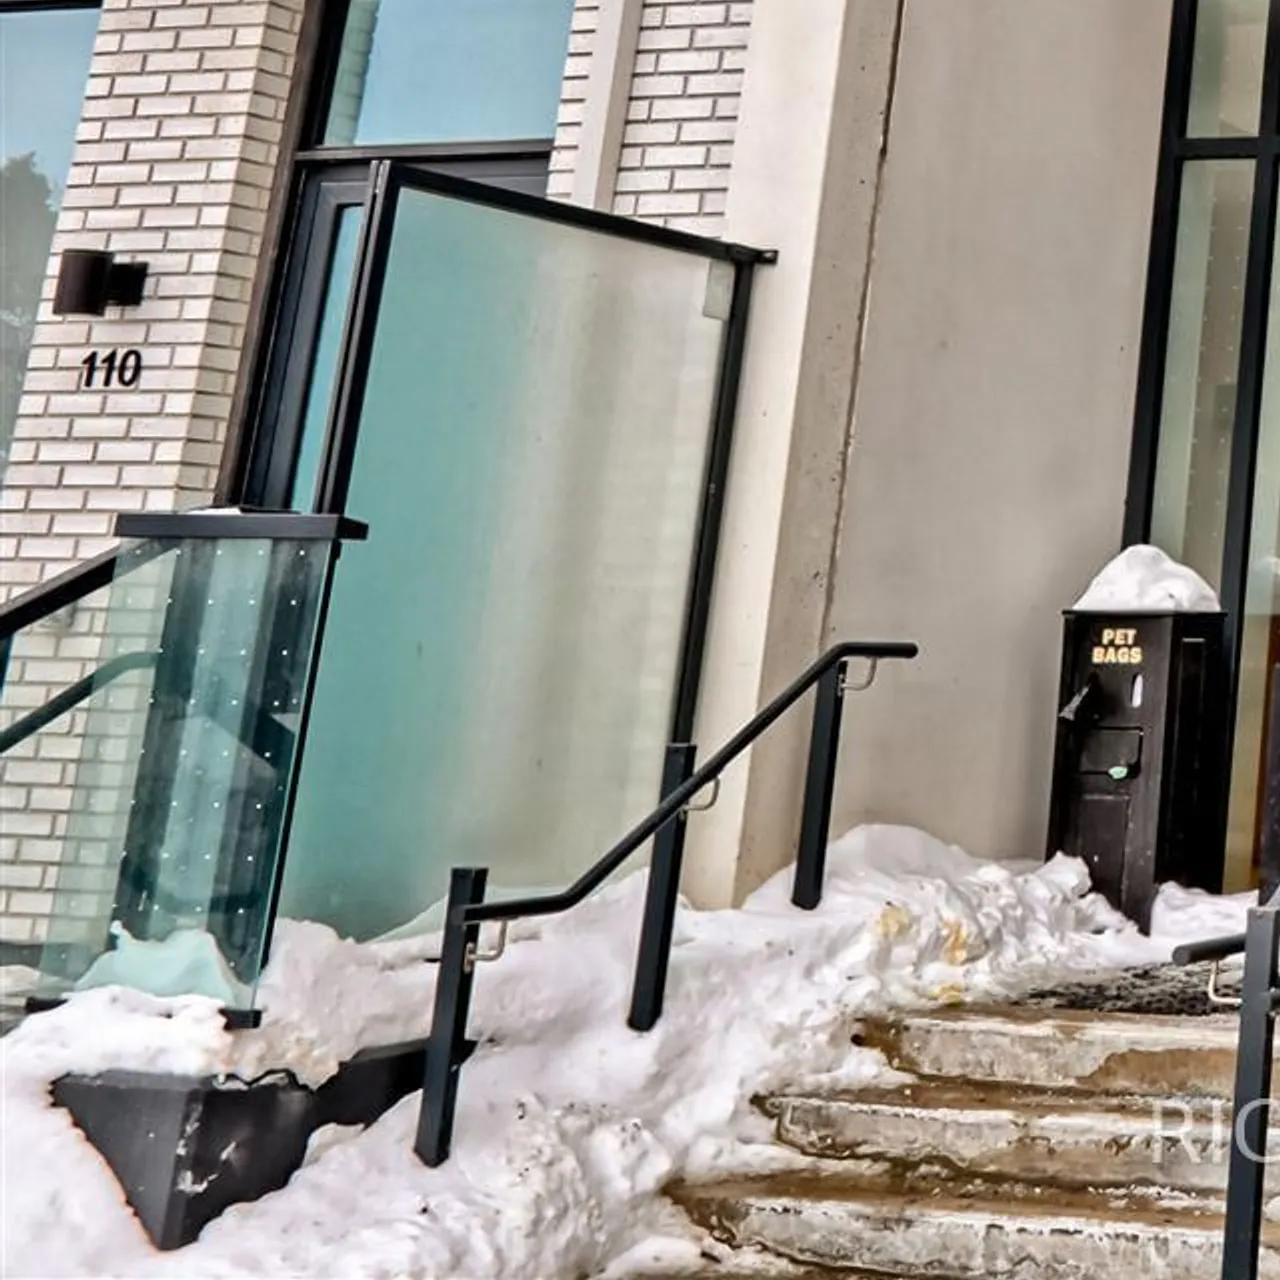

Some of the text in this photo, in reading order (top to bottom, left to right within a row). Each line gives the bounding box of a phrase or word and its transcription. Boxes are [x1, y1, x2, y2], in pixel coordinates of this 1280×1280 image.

[82, 348, 142, 387] 110
[1102, 628, 1137, 645] PET
[1092, 647, 1143, 664] BAGS
